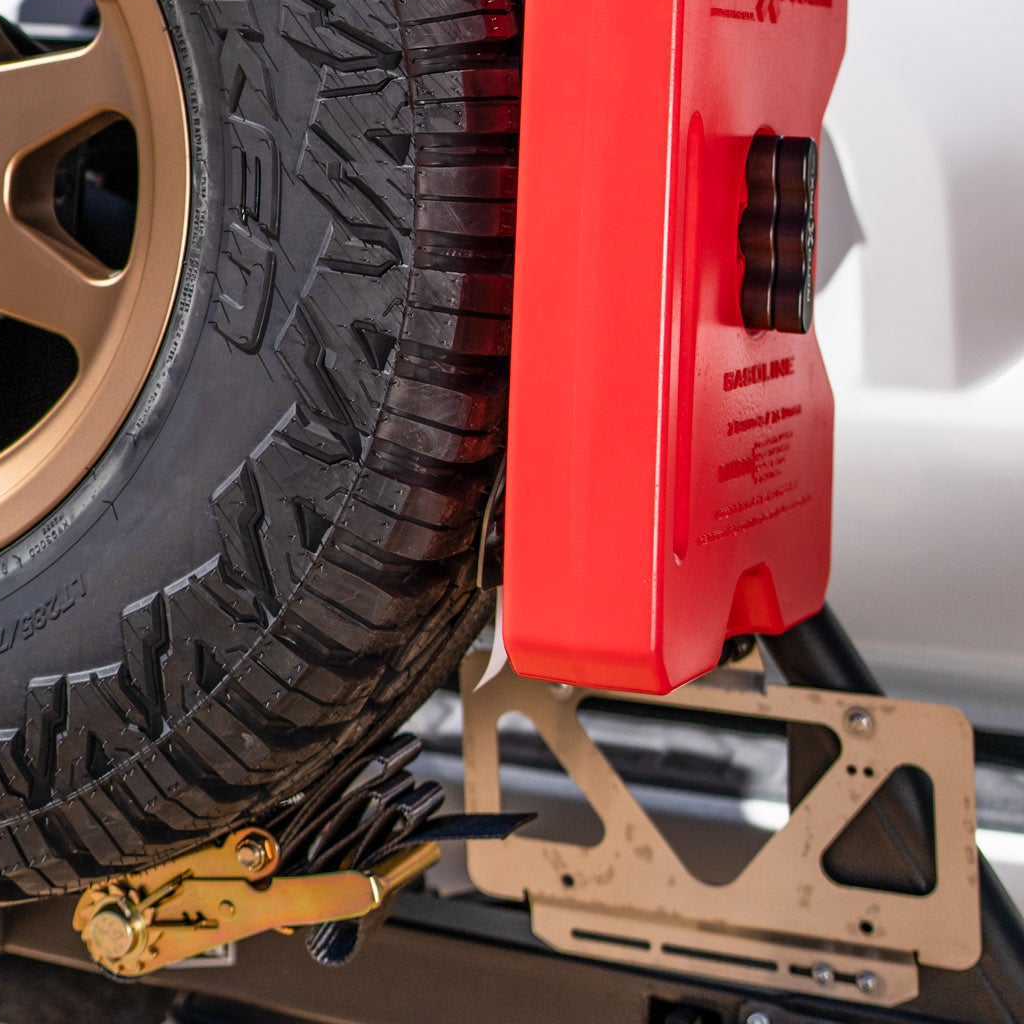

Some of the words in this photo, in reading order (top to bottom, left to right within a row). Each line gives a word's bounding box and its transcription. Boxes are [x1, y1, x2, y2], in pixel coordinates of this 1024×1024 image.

[172, 24, 189, 61] STEEL
[184, 65, 199, 113] BELTED
[193, 117, 203, 157] RADIAL
[723, 356, 795, 392] GASOLINE
